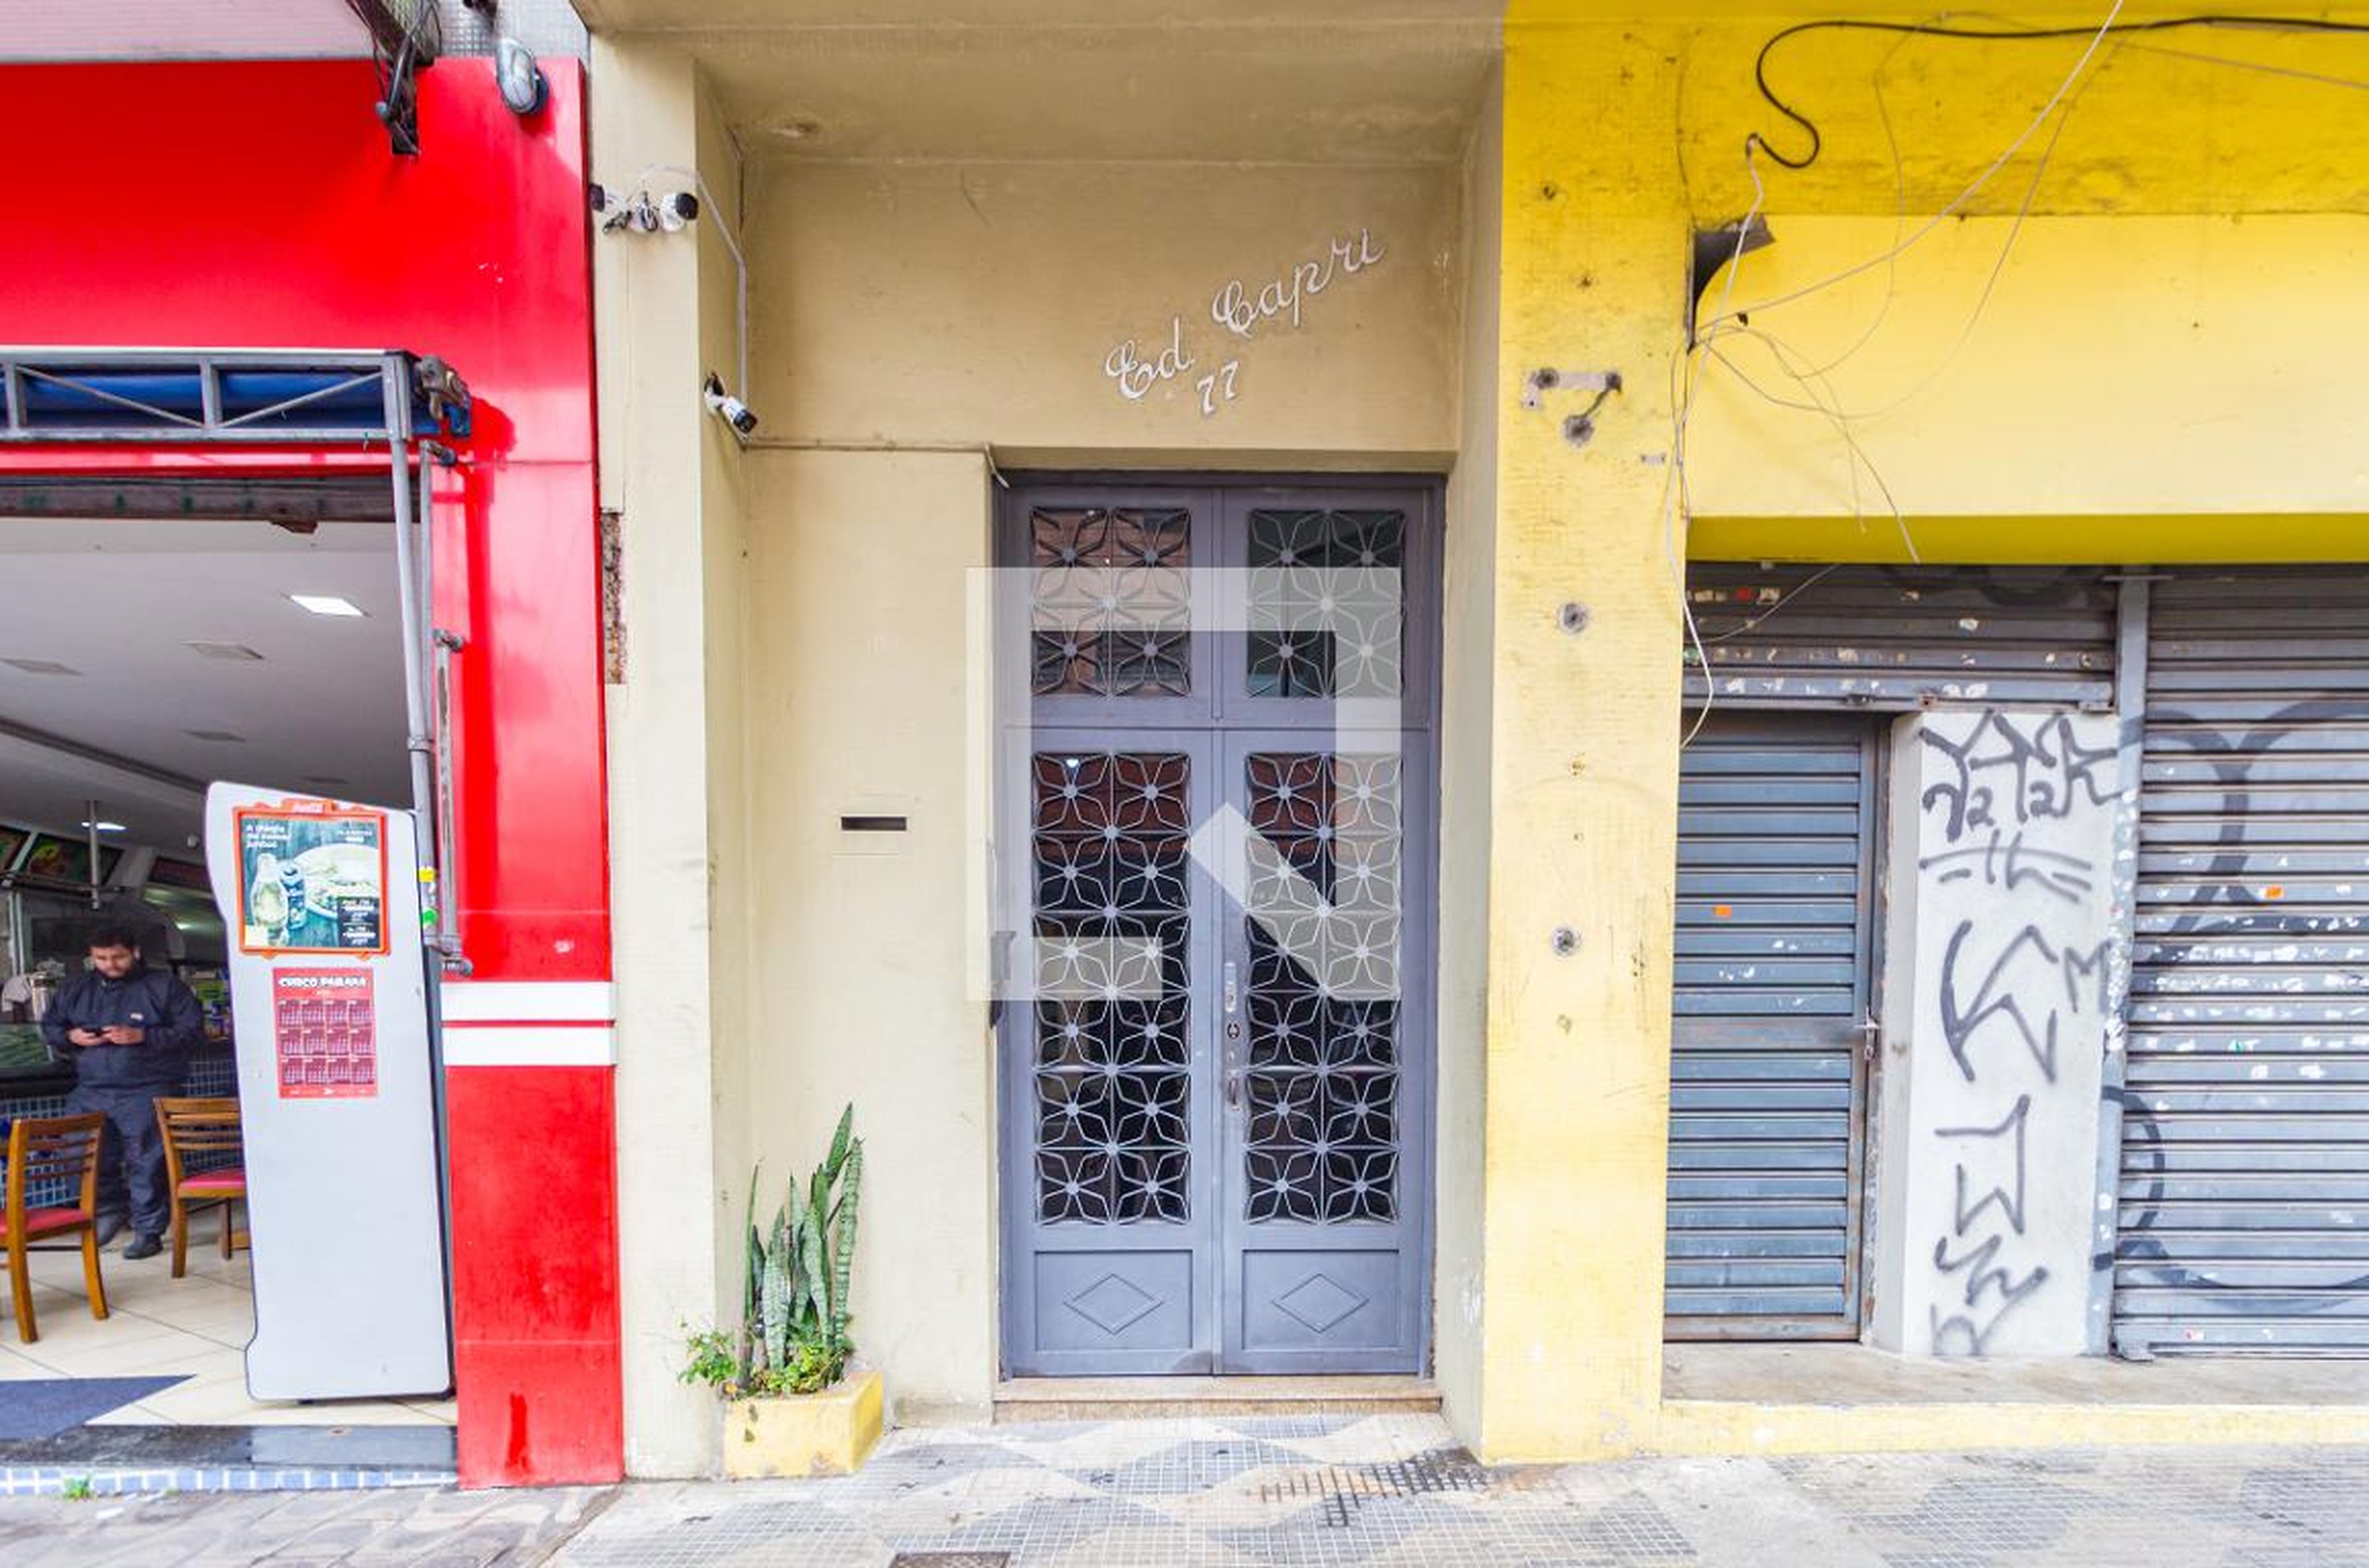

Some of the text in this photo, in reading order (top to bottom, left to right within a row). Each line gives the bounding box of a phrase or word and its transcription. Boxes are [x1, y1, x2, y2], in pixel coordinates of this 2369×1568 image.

[1105, 227, 1387, 400] Ed Capri
[1196, 360, 1240, 416] 77
